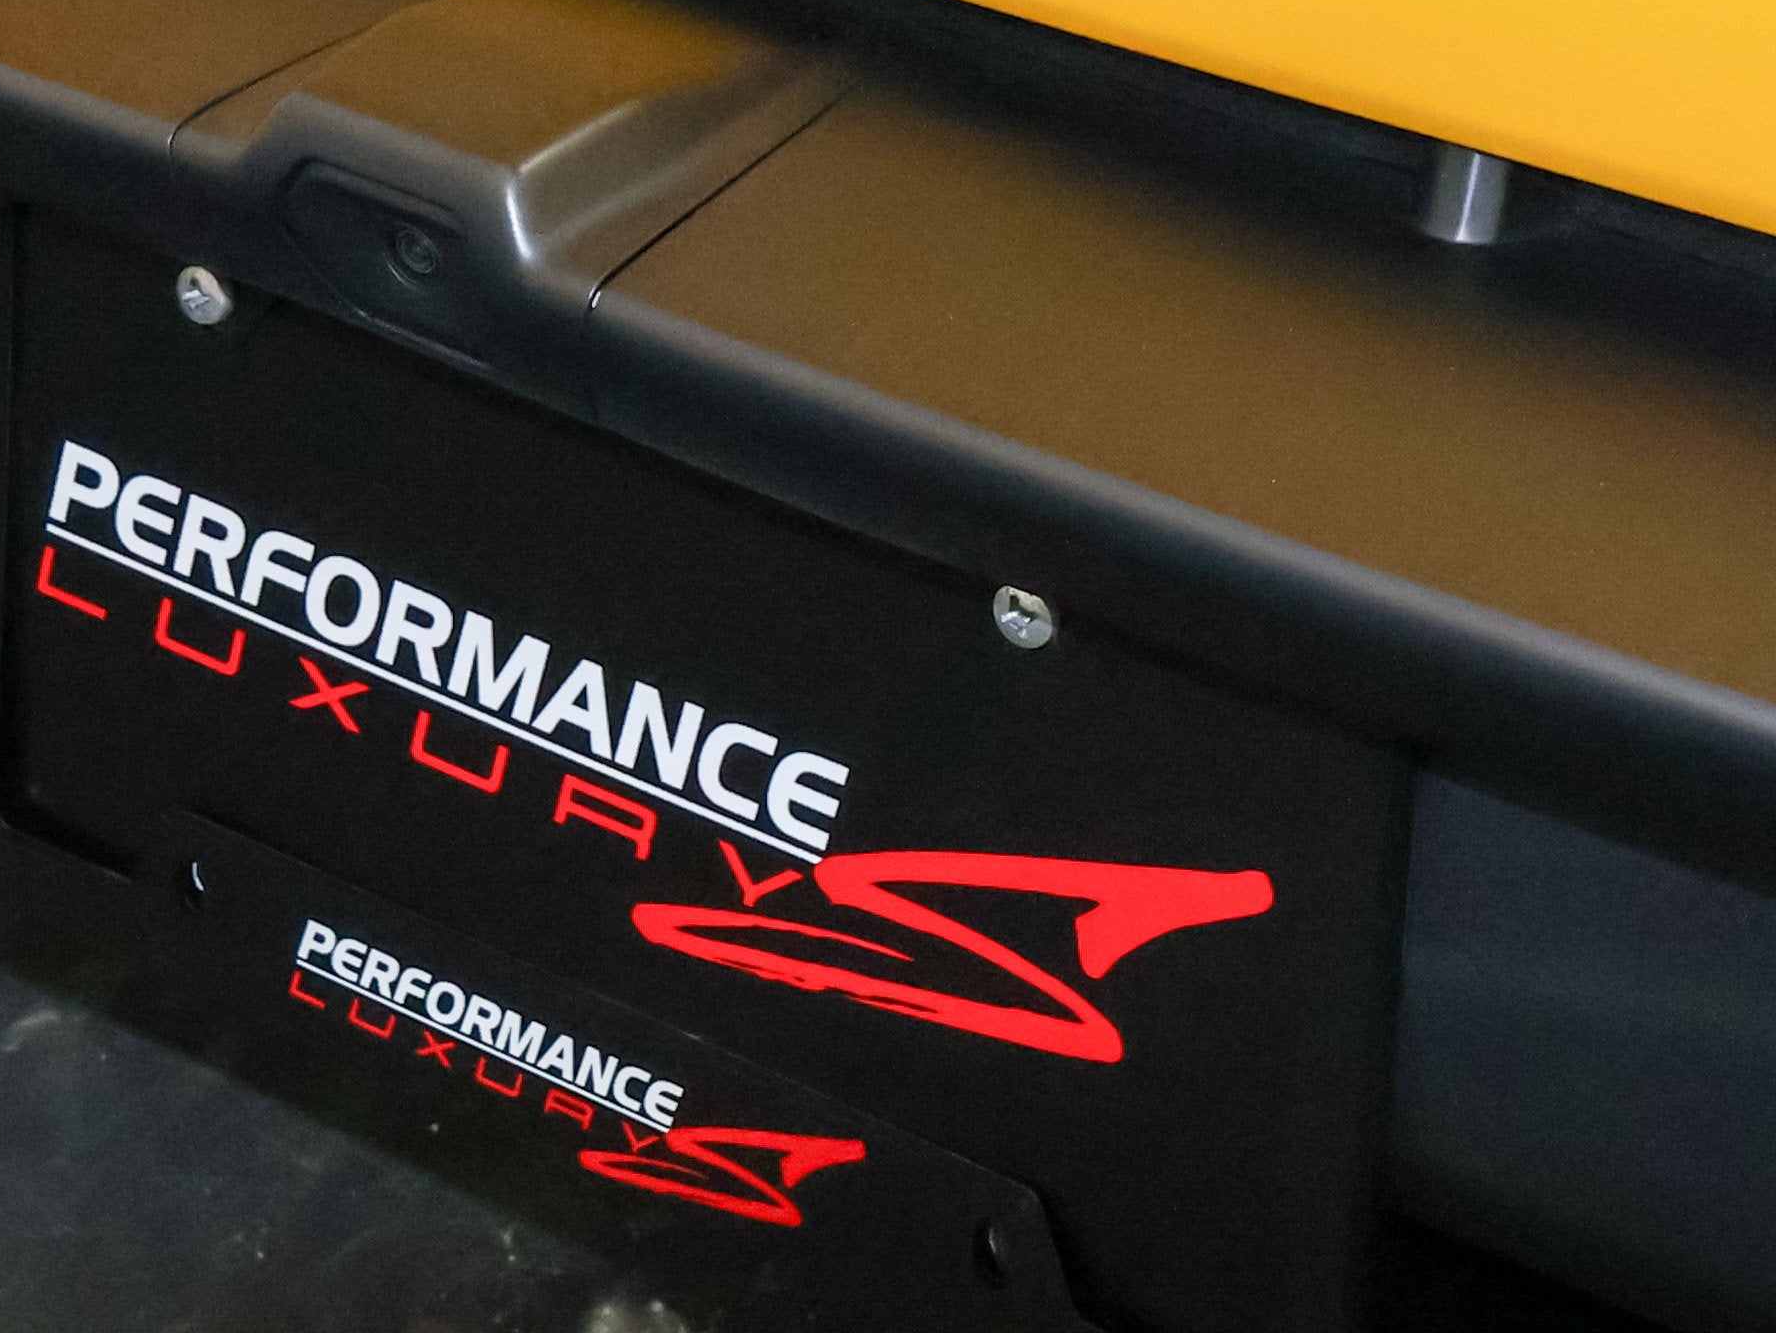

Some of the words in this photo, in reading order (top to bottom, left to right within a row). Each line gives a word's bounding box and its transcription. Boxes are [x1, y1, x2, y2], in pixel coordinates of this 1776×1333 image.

[35, 544, 805, 909] LUXURY
[47, 438, 851, 853] PERFORMANCE
[288, 969, 661, 1155] LUXURY
[296, 918, 685, 1128] PERFORMANCE
